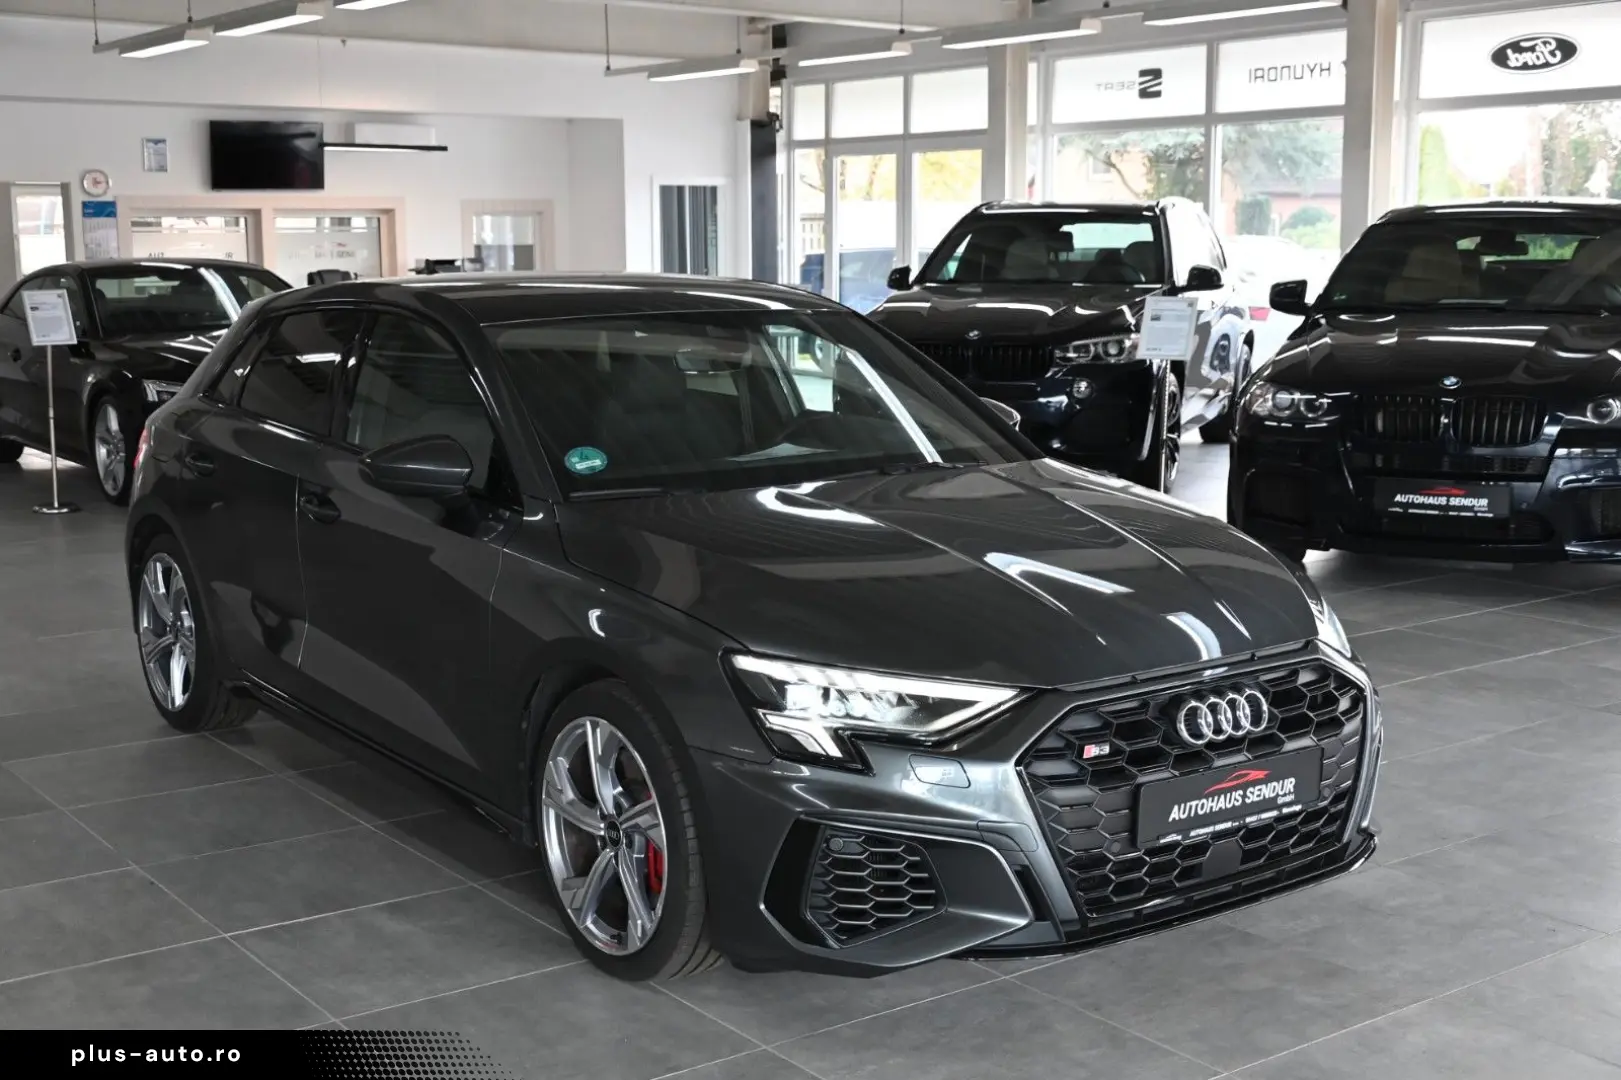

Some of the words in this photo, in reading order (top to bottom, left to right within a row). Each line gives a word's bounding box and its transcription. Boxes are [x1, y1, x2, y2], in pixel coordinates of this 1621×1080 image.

[1394, 493, 1447, 505] AUTOHAUS
[1448, 497, 1488, 507] SENDUR
[1168, 790, 1243, 822] AUTOHAUS
[1244, 777, 1296, 804] SENDUR
[1277, 793, 1295, 804] GmbH
